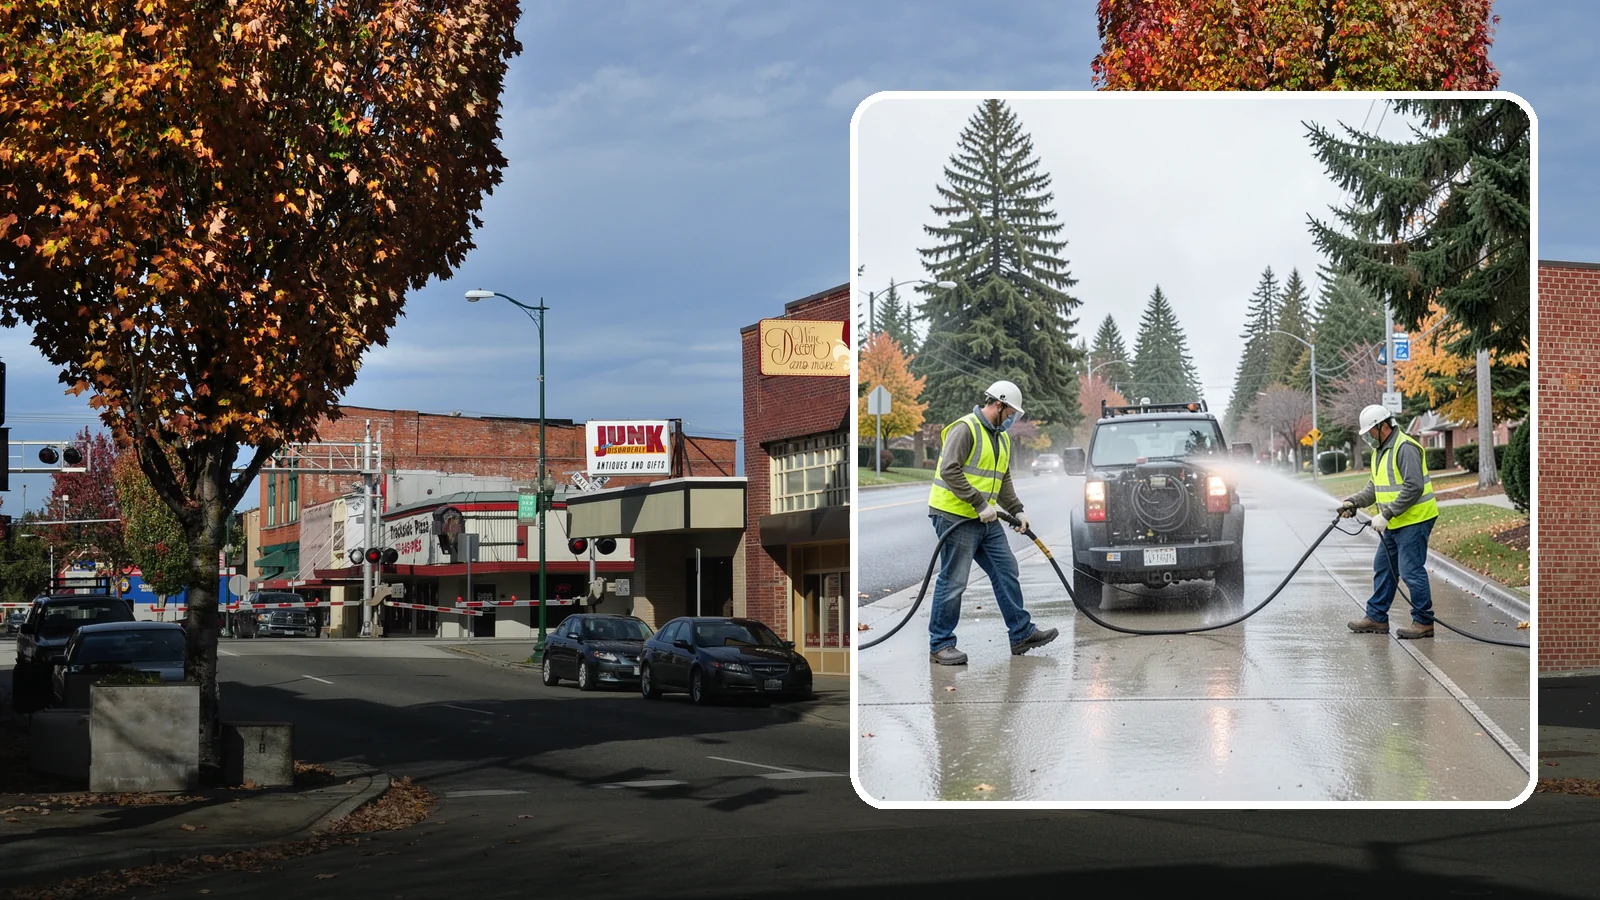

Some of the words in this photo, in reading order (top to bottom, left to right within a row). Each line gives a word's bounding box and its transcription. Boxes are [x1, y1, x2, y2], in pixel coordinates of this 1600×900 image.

[595, 425, 665, 457] JUNK
[607, 446, 646, 454] DISORDERLY
[597, 461, 628, 470] ANTIQUES
[631, 461, 644, 470] AND
[647, 460, 665, 469] GIFTS
[390, 521, 412, 540] Trackside
[415, 519, 429, 535] Pizza
